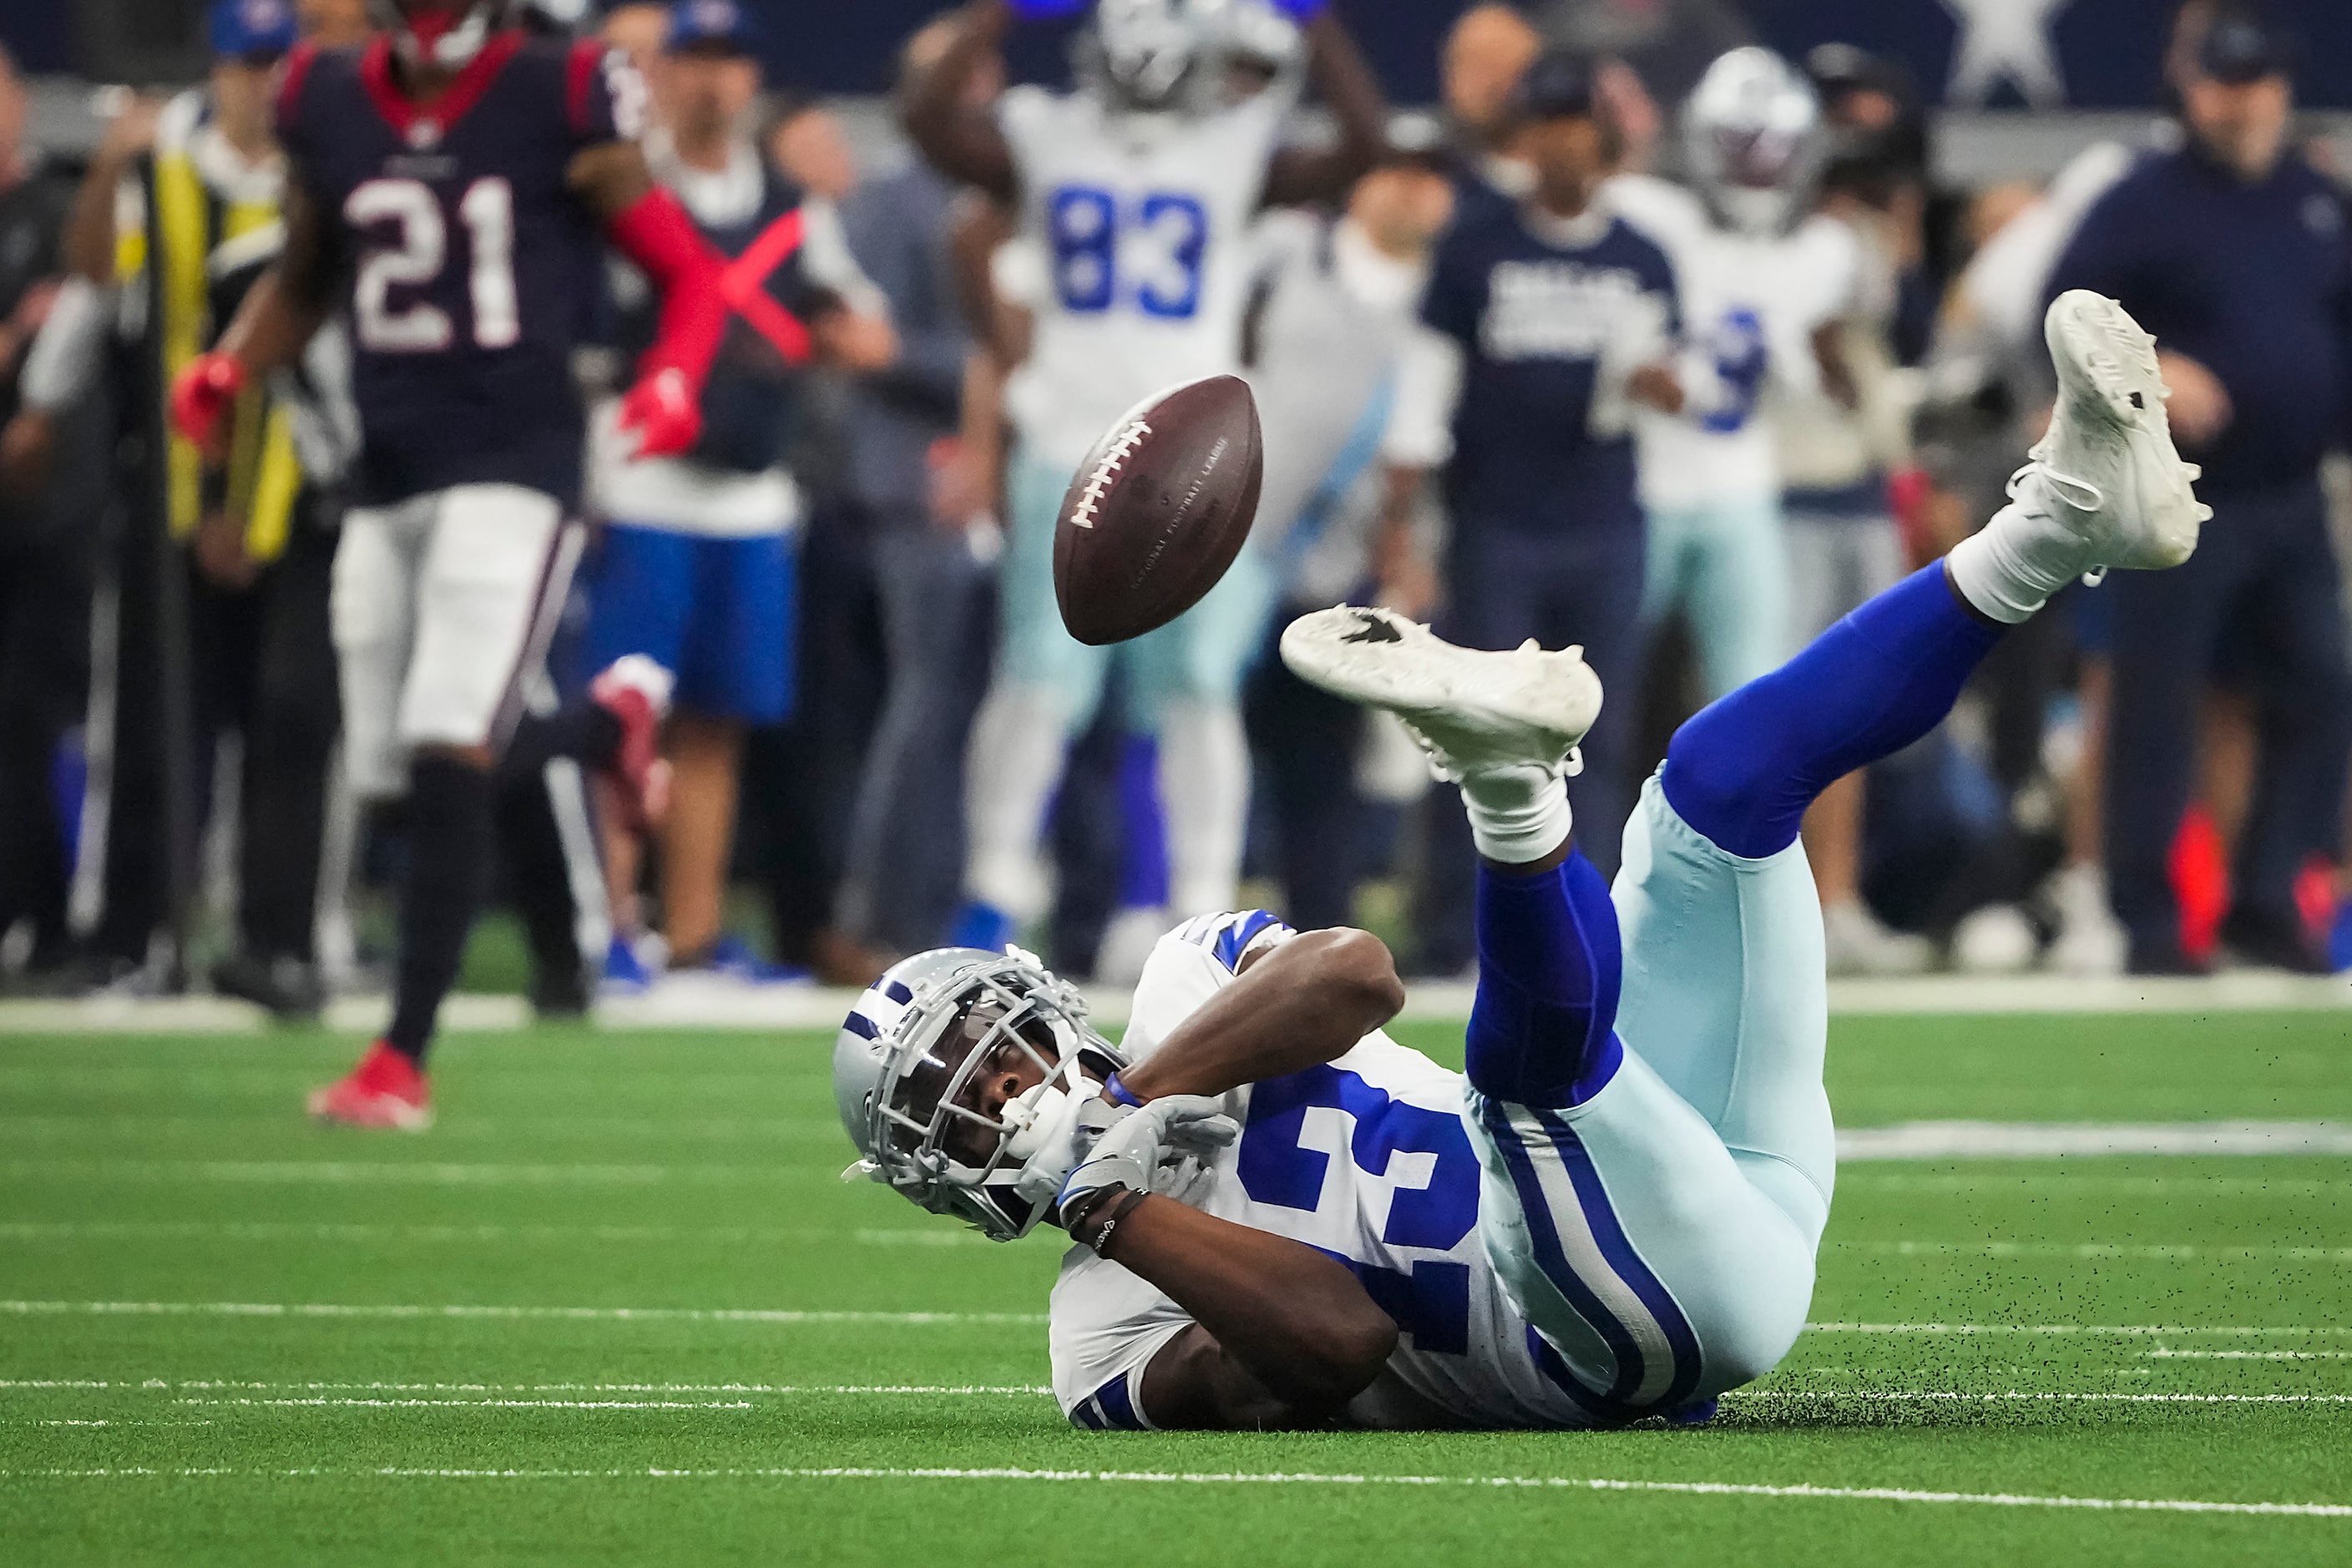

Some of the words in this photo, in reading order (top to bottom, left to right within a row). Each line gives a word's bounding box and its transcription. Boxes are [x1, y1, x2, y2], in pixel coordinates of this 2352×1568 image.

[342, 177, 521, 352] 21
[1047, 185, 1206, 320] 83
[1166, 478, 1203, 535] FOOTBALL
[1201, 435, 1230, 477] LEAGUE
